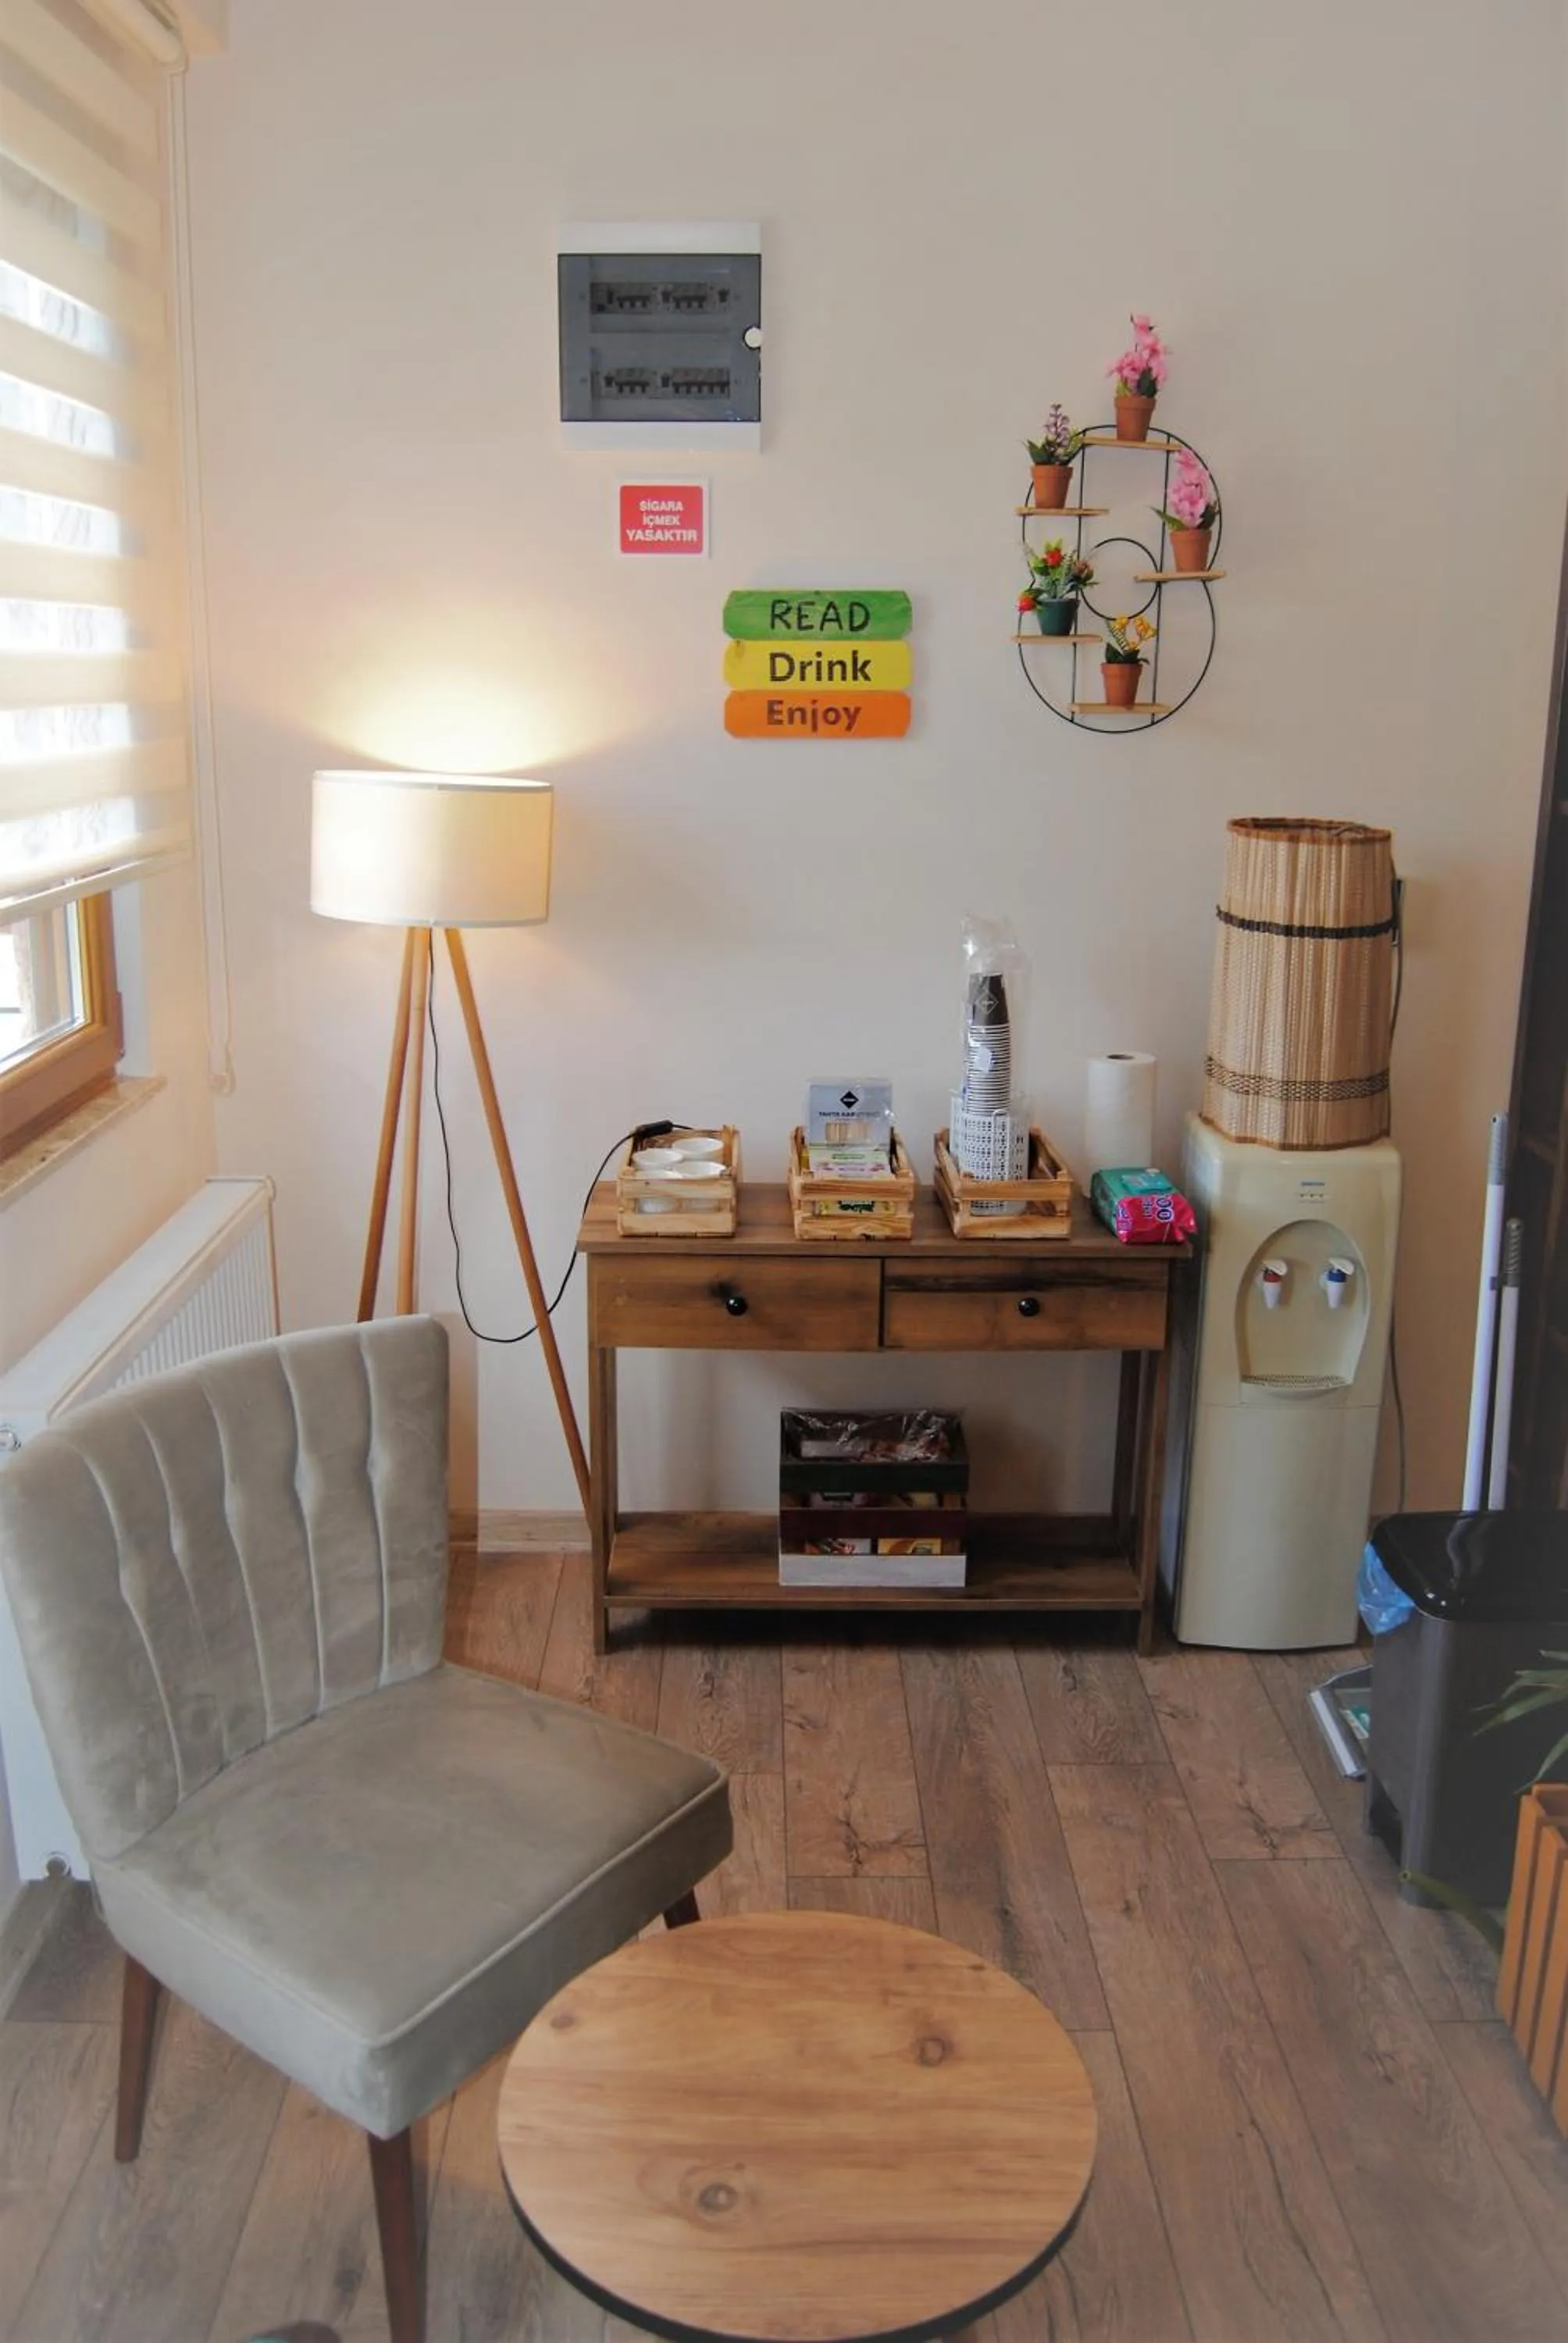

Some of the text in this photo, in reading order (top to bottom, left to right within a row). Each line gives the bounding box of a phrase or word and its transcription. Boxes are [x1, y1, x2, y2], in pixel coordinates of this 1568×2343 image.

[639, 498, 684, 512] SİGARA
[642, 512, 681, 528] İÇMEK
[625, 529, 697, 542] YASAKTIR
[769, 599, 871, 632] READ
[769, 650, 872, 682] Drink
[766, 700, 862, 733] Enjoy
